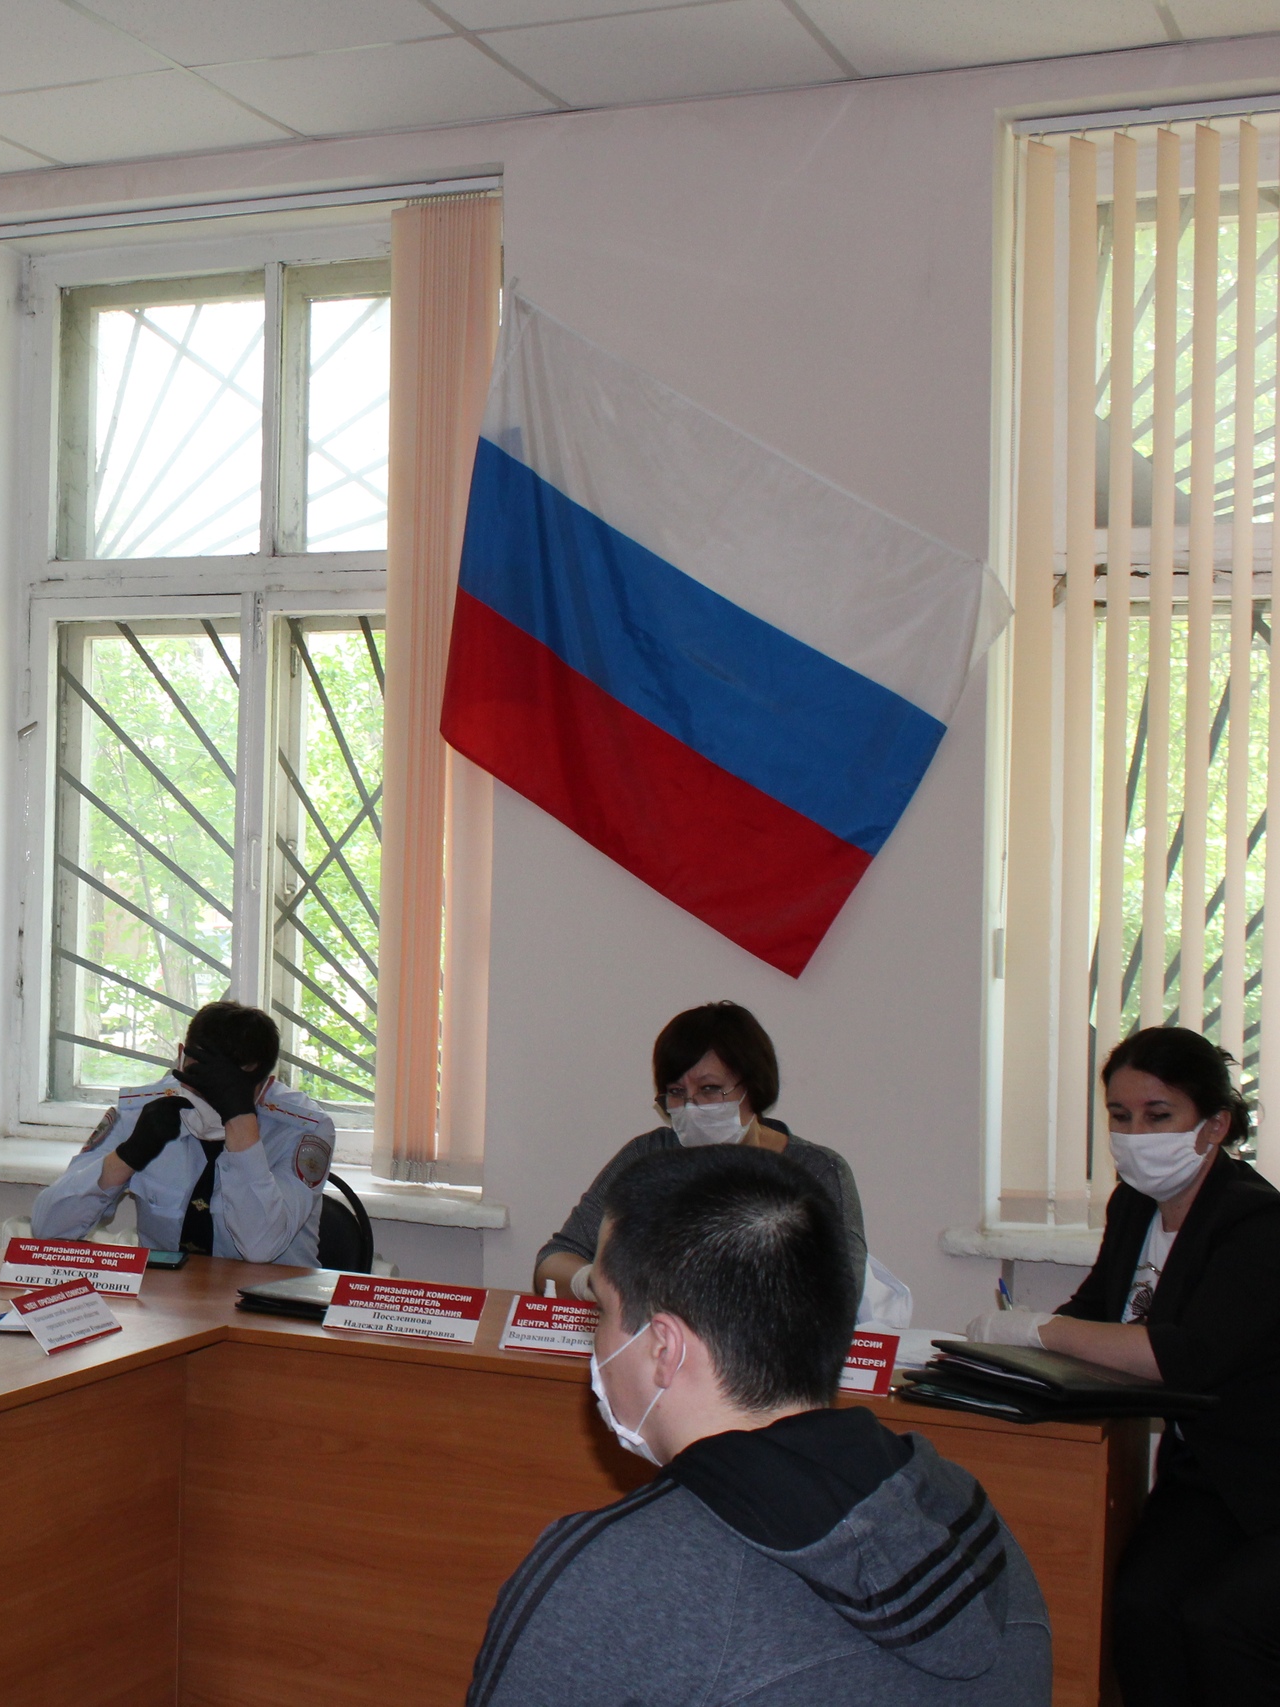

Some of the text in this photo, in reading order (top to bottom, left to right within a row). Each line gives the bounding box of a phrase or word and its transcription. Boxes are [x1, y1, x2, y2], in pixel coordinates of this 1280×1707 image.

[20, 1244, 135, 1260] ЧЛЕН ПРИЗЫВНОЙ КОМИССИИ
[32, 1253, 118, 1267] ПРЕДСТАВИТЕЛЬ ОВД
[15, 1275, 43, 1283] ОЛЕГ
[51, 1268, 99, 1278] ЗЕМСКОВ
[23, 1286, 90, 1311] ЧЛЕН ПРИЗЫВНОЙ КОМИССИИ
[349, 1283, 472, 1303] ЧЛЕН ПРИЗЫВНОЙ КОМИССИИ
[373, 1294, 441, 1307] ПРЕДСТАВИТЕЛЬ
[348, 1300, 462, 1318] УПРАВЛЕНИЯ ОБРАЗОВАНИЯ
[526, 1303, 599, 1316] ЧЛЕН ПРИЗЫВНО
[344, 1319, 455, 1339] Надежда Владимировна
[517, 1319, 596, 1332] ЦЕНТРА ЗАНЯТОСТ
[509, 1331, 555, 1342] Варакина
